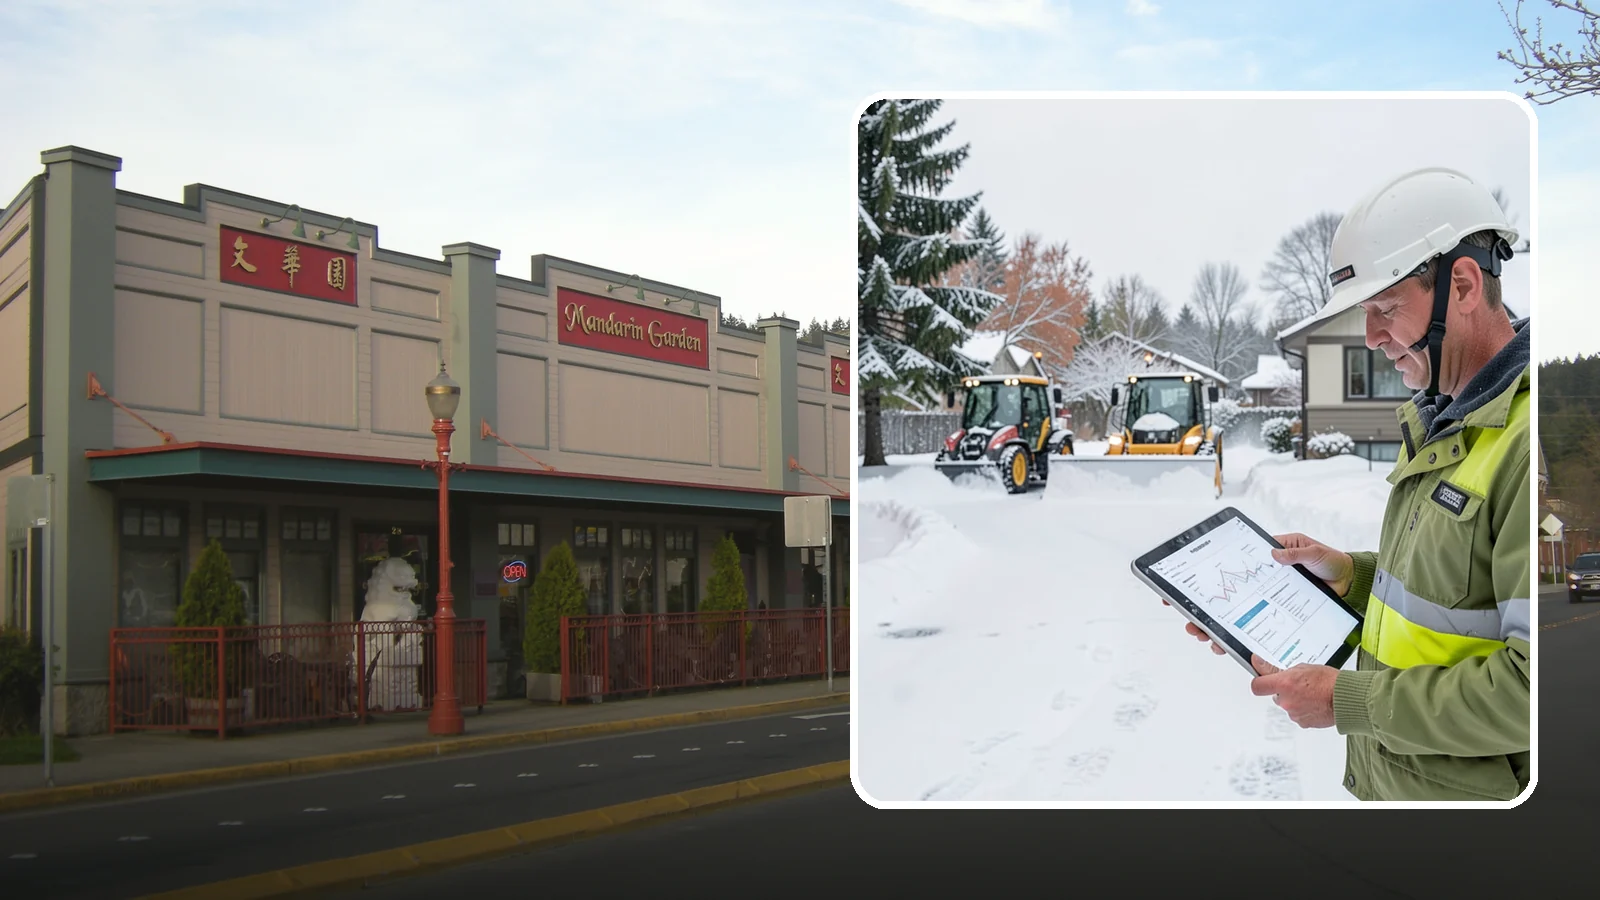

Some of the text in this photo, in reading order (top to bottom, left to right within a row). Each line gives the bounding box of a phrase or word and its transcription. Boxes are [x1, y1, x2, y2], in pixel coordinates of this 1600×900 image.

[564, 302, 702, 352] Mandarin Garden
[503, 565, 527, 578] OPEN
